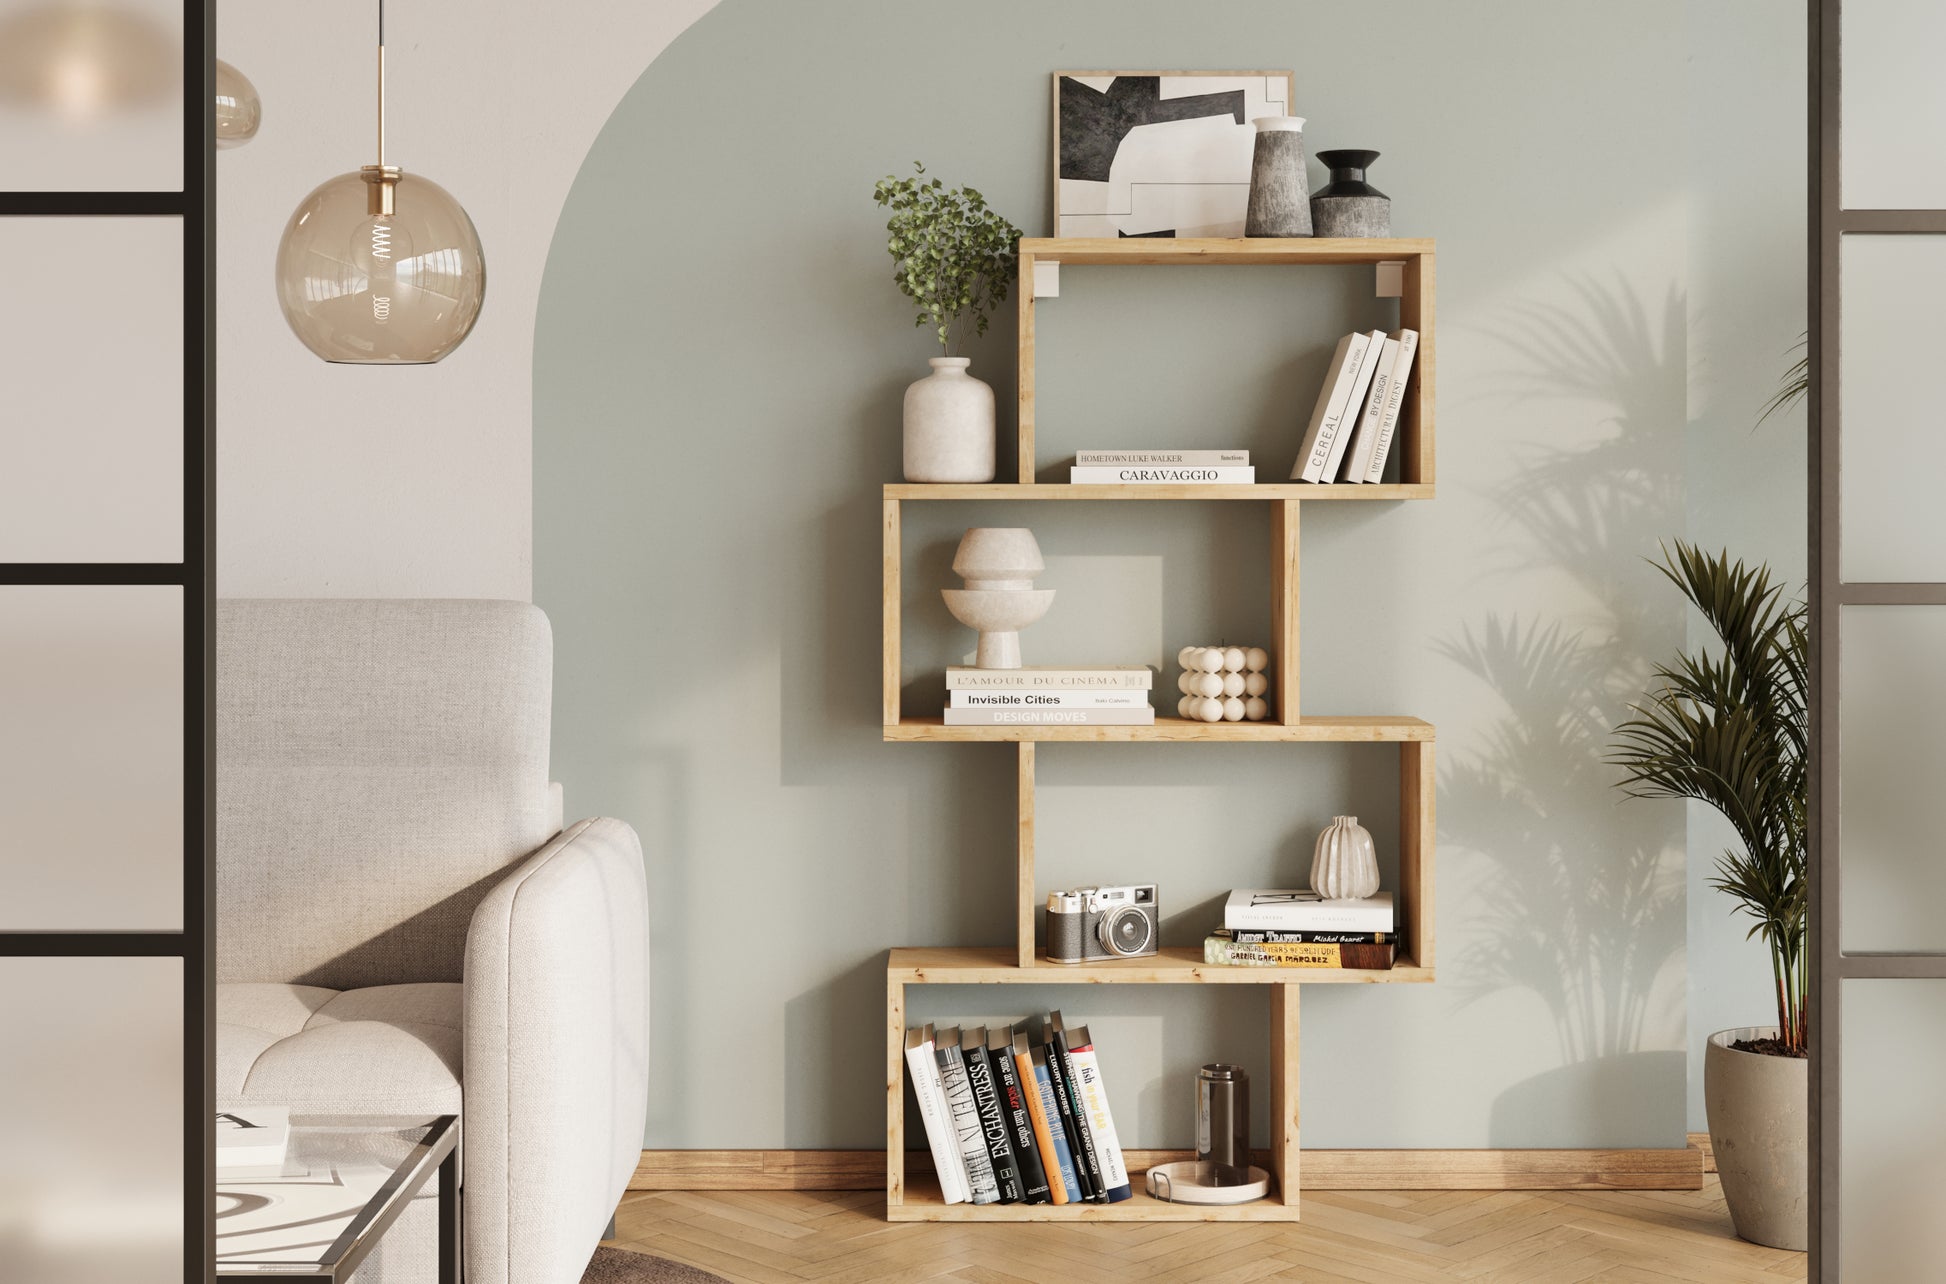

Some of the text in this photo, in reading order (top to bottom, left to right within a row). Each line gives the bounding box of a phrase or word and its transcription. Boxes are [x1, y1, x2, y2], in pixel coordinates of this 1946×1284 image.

[1373, 374, 1388, 406] DESIGN
[1370, 405, 1379, 417] BY
[1371, 379, 1403, 475] ARCHITECTURAL DIGEST
[1081, 454, 1182, 462] HOMETOWN LUKE WALKER
[1311, 414, 1339, 467] CEREAL
[1119, 470, 1218, 481] CARAVAGGIO
[957, 676, 1024, 685] L'AMOUR
[1034, 676, 1054, 685] DU
[968, 695, 1060, 704] Invisible Cities
[994, 712, 1088, 722] DESIGN MOVES
[1231, 952, 1255, 960] GABRIEL
[1267, 945, 1288, 953] YEARS
[940, 1060, 976, 1122] TRAVEL
[999, 1055, 1031, 1148] some are sicker than others
[1050, 1054, 1070, 1116] LUXURY HOUSES
[1063, 1051, 1076, 1080] STEPHEN
[1071, 1079, 1085, 1113] HAWKING
[1081, 1067, 1095, 1084] fish
[1093, 1112, 1107, 1129] EAR
[970, 1063, 1010, 1159] ENCHANTRESS
[1038, 1080, 1066, 1141] GATHERING BLUE
[957, 1124, 982, 1142] IN
[1078, 1115, 1099, 1175] THE GRAND DESIGN
[964, 1143, 994, 1183] TIME
